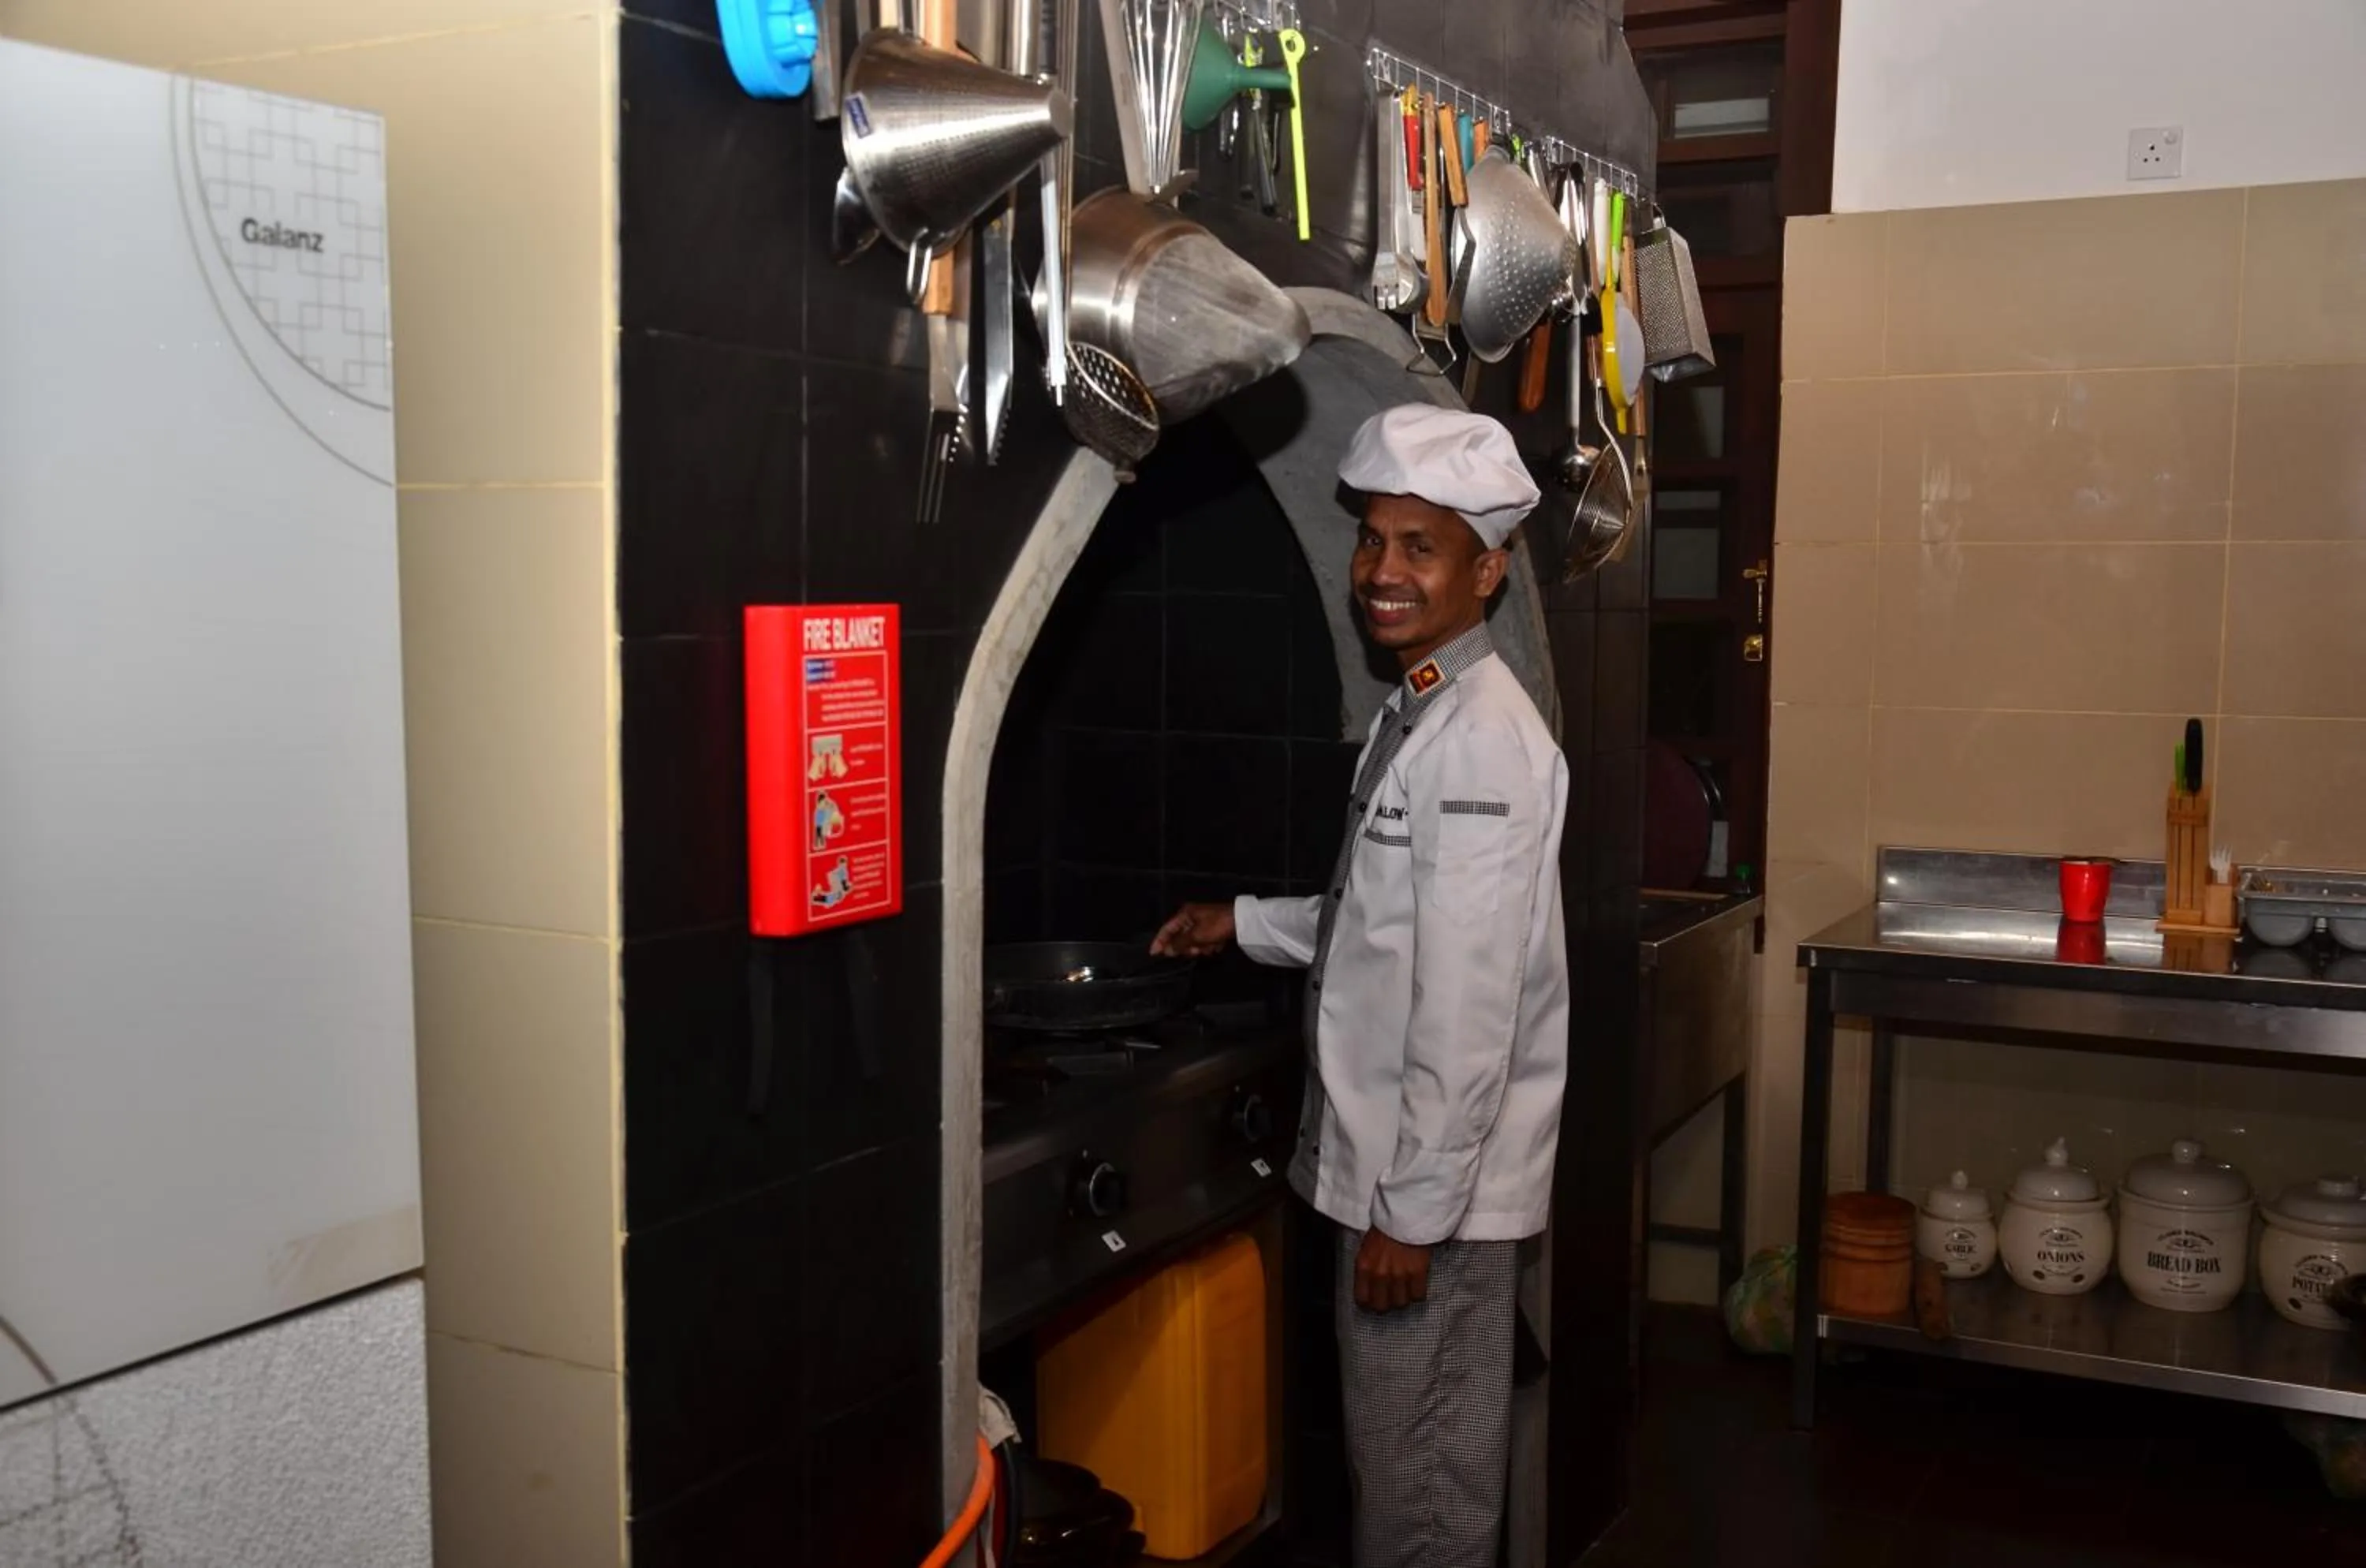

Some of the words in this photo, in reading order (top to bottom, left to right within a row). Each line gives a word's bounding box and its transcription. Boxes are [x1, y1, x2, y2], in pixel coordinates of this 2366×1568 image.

[240, 217, 324, 254] Galanz
[803, 618, 831, 651] FIRE
[832, 615, 886, 650] BLANKET
[2036, 1250, 2085, 1263] ONIONS
[2147, 1251, 2192, 1273] BREAD
[2194, 1256, 2222, 1274] BOX
